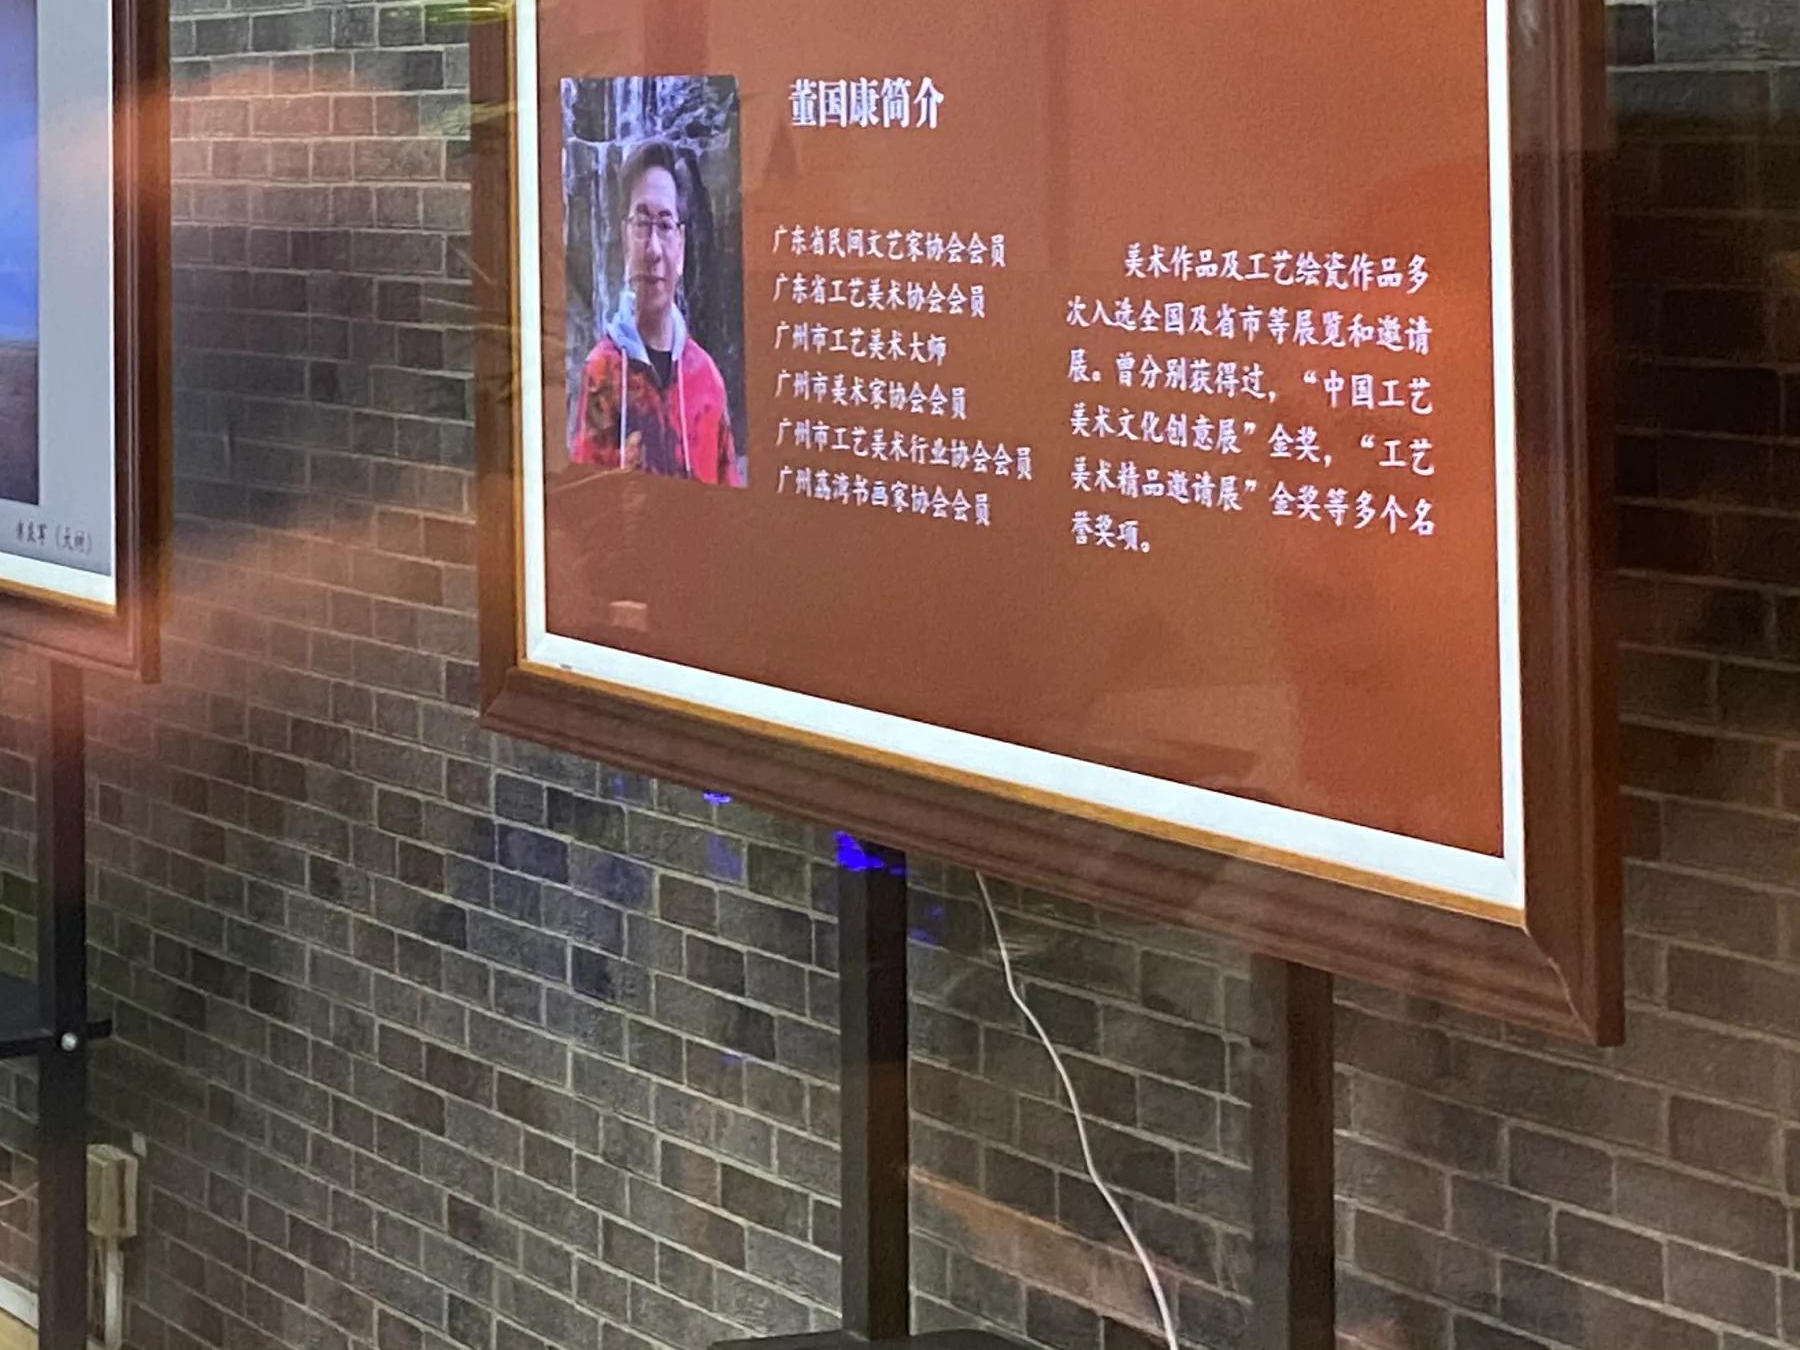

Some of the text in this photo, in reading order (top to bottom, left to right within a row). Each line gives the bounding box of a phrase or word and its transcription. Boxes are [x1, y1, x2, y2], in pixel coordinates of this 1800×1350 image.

[788, 77, 944, 128] 董国康简介
[772, 224, 1006, 268] 广东省民间文艺家协会会员
[1125, 242, 1430, 295] 美术作品及工艺绘瓷作品多
[773, 272, 985, 318] 广东省工艺美术协会会员
[774, 321, 947, 366] 广州市工艺美术大师
[1066, 295, 1433, 355] 次入选全国及省市等展览和邀请
[775, 369, 967, 420] 广州市美术家协会会员
[776, 417, 1033, 480] 广州市工艺美术行业协会会员
[777, 465, 991, 527] 广州荔湾书画家协会会员
